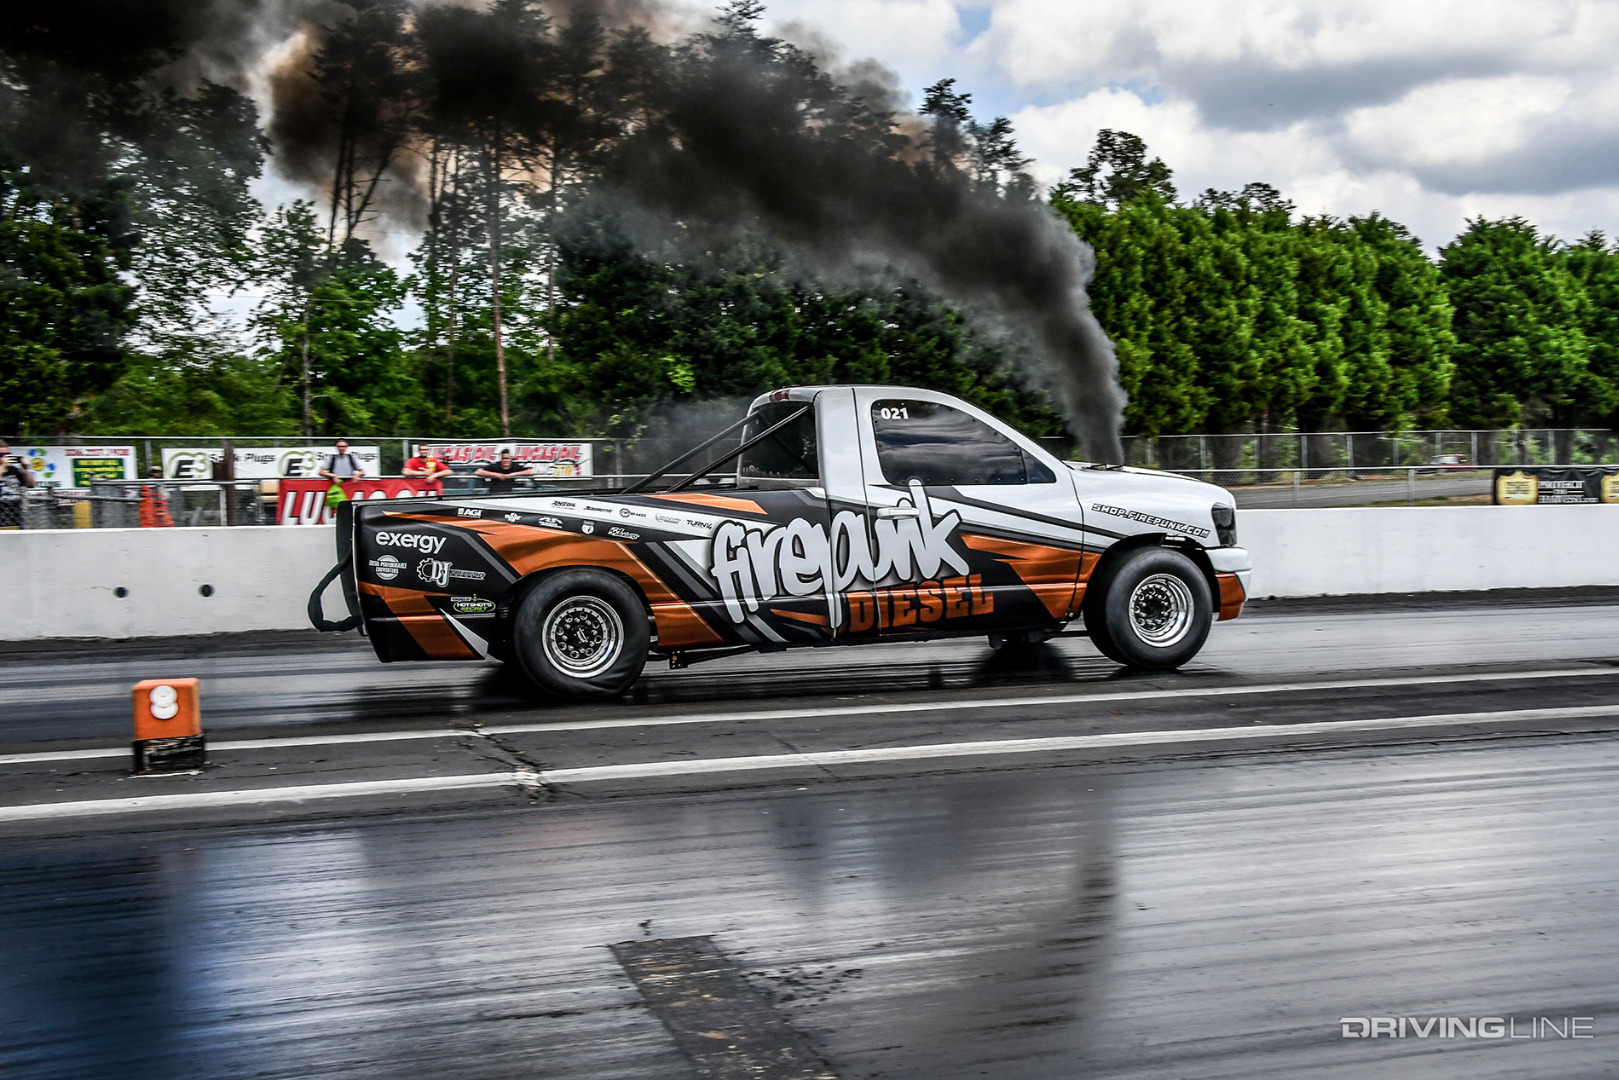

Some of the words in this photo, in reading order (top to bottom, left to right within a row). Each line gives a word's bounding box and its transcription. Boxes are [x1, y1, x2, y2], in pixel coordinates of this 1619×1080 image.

[880, 407, 909, 420] 021
[1091, 502, 1211, 539] SHOP.FIREPUNK.COM
[375, 531, 446, 554] exergy
[711, 478, 970, 630] firepunk
[847, 573, 994, 633] DIESEL
